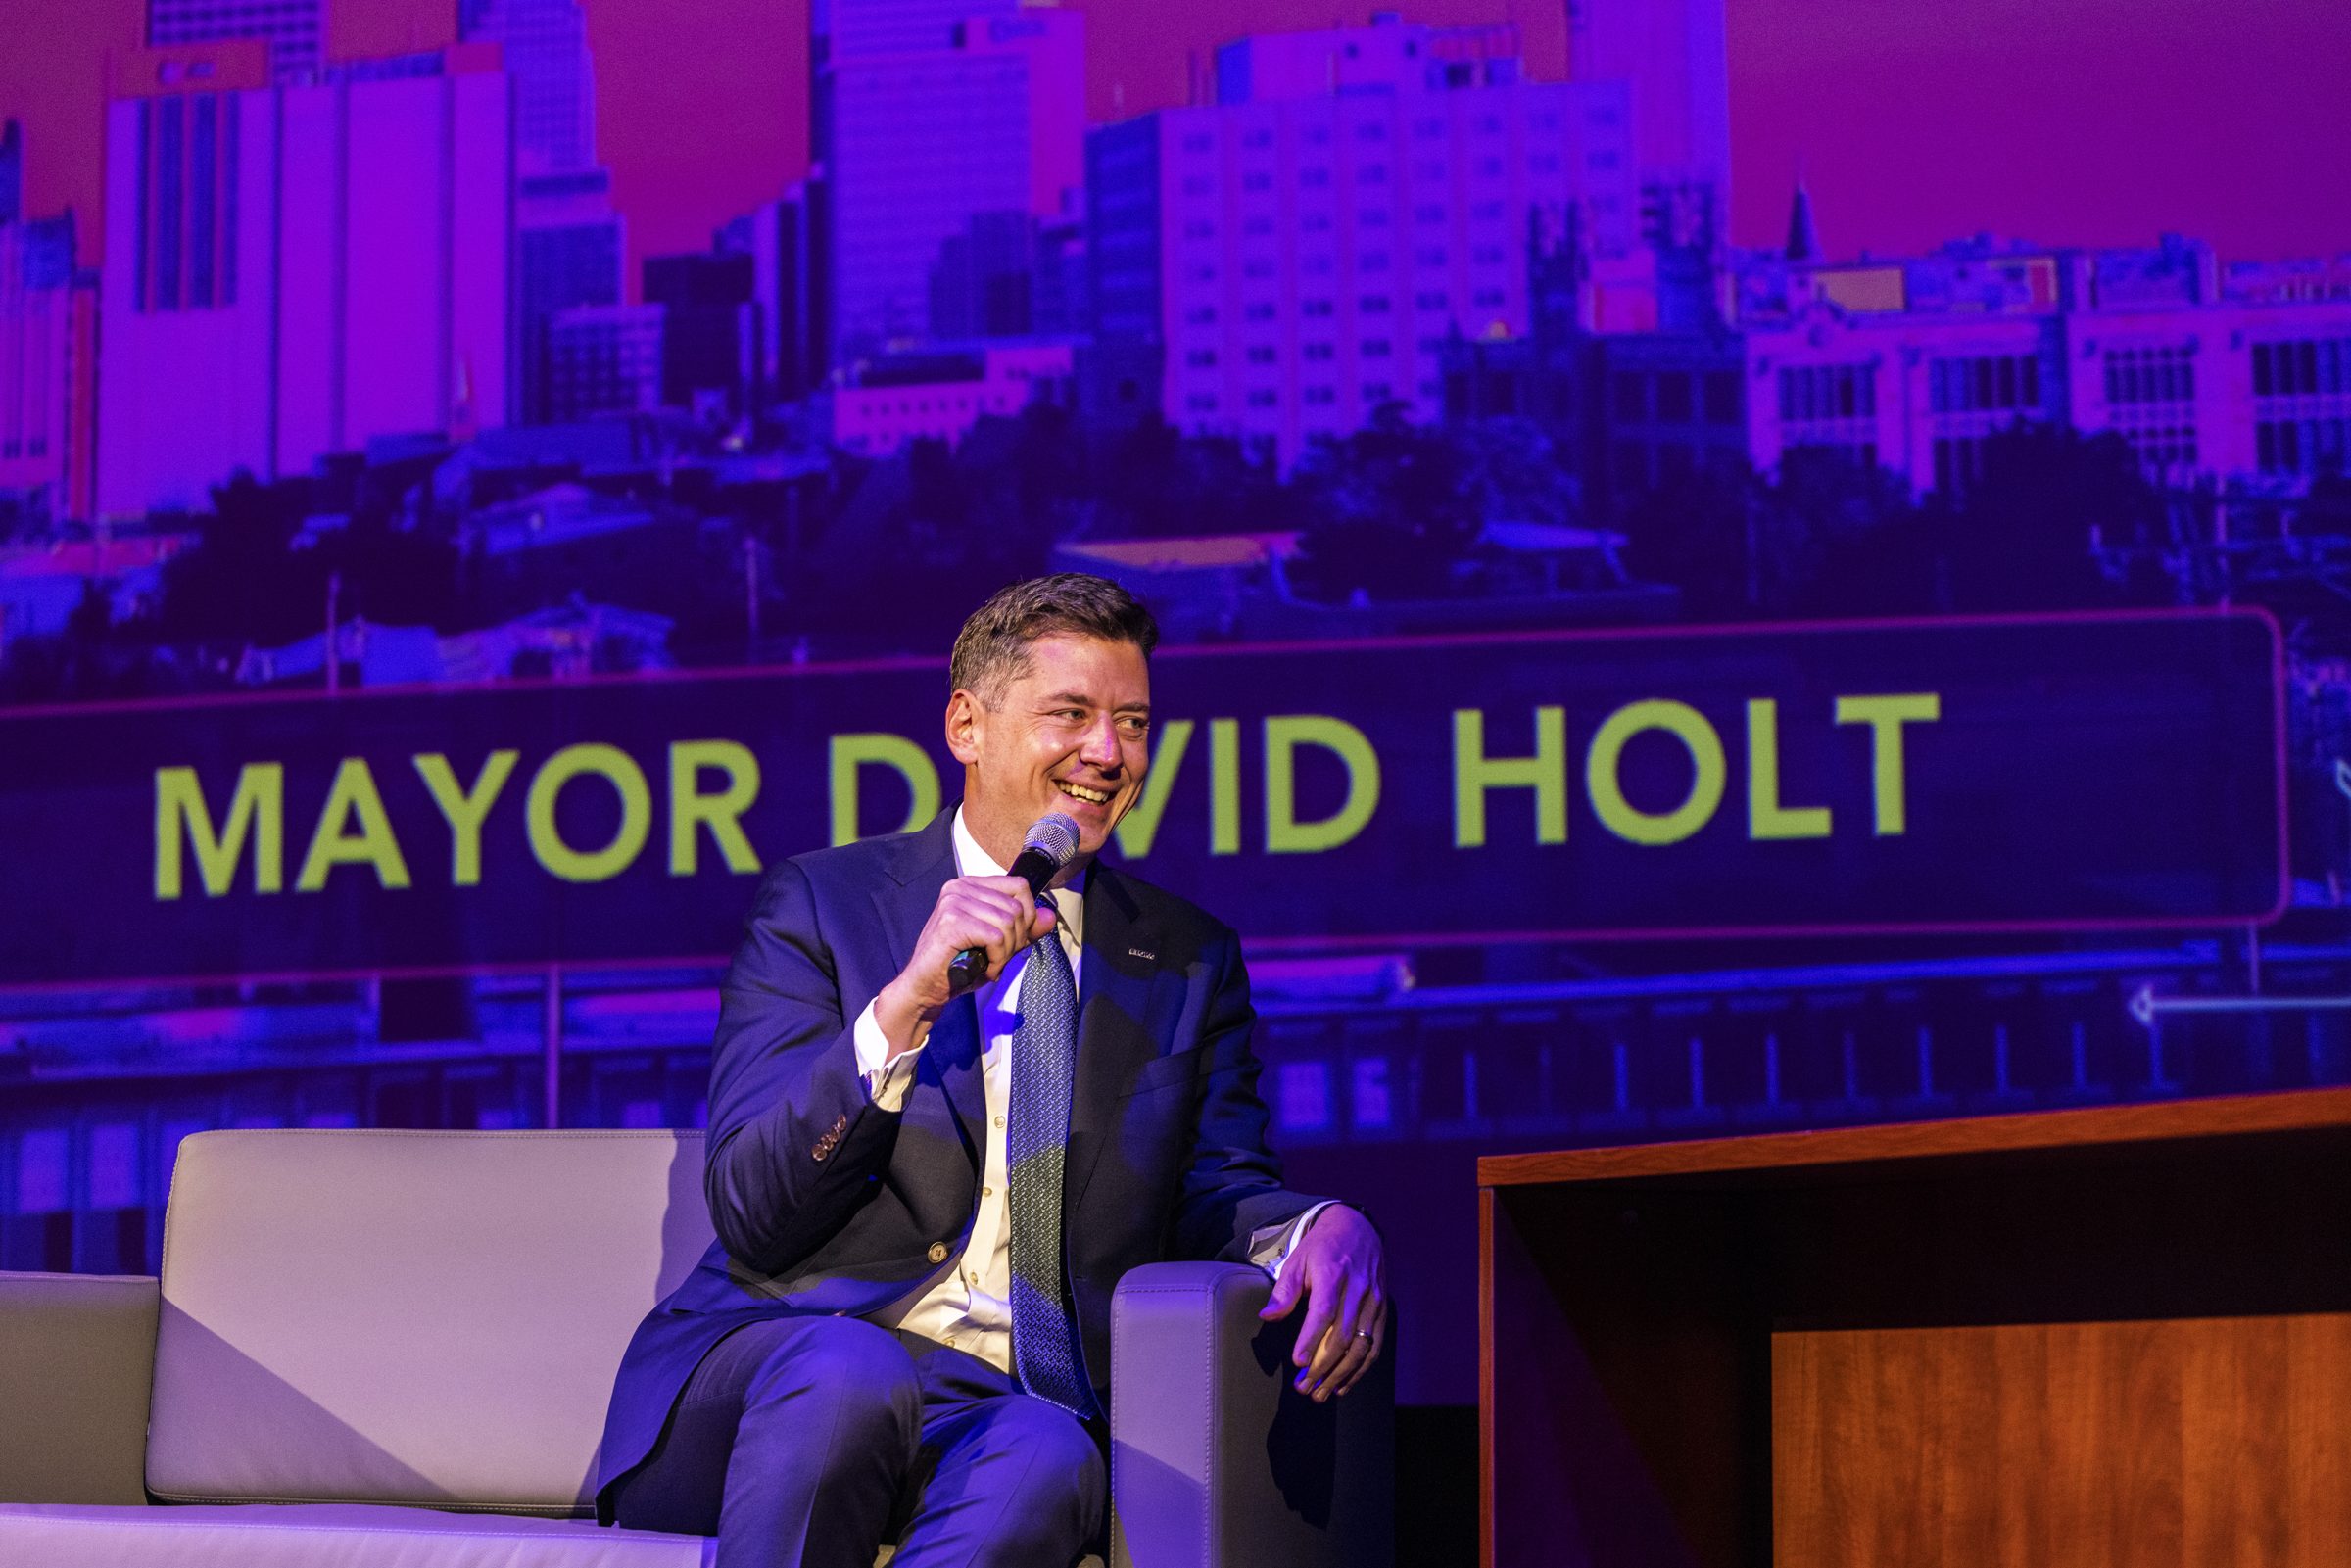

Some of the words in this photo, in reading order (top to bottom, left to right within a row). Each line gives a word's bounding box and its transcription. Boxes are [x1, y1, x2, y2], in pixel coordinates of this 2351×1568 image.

[154, 739, 761, 900] MAYOR
[830, 715, 1380, 856] DVID
[1454, 693, 1941, 848] HOLT
